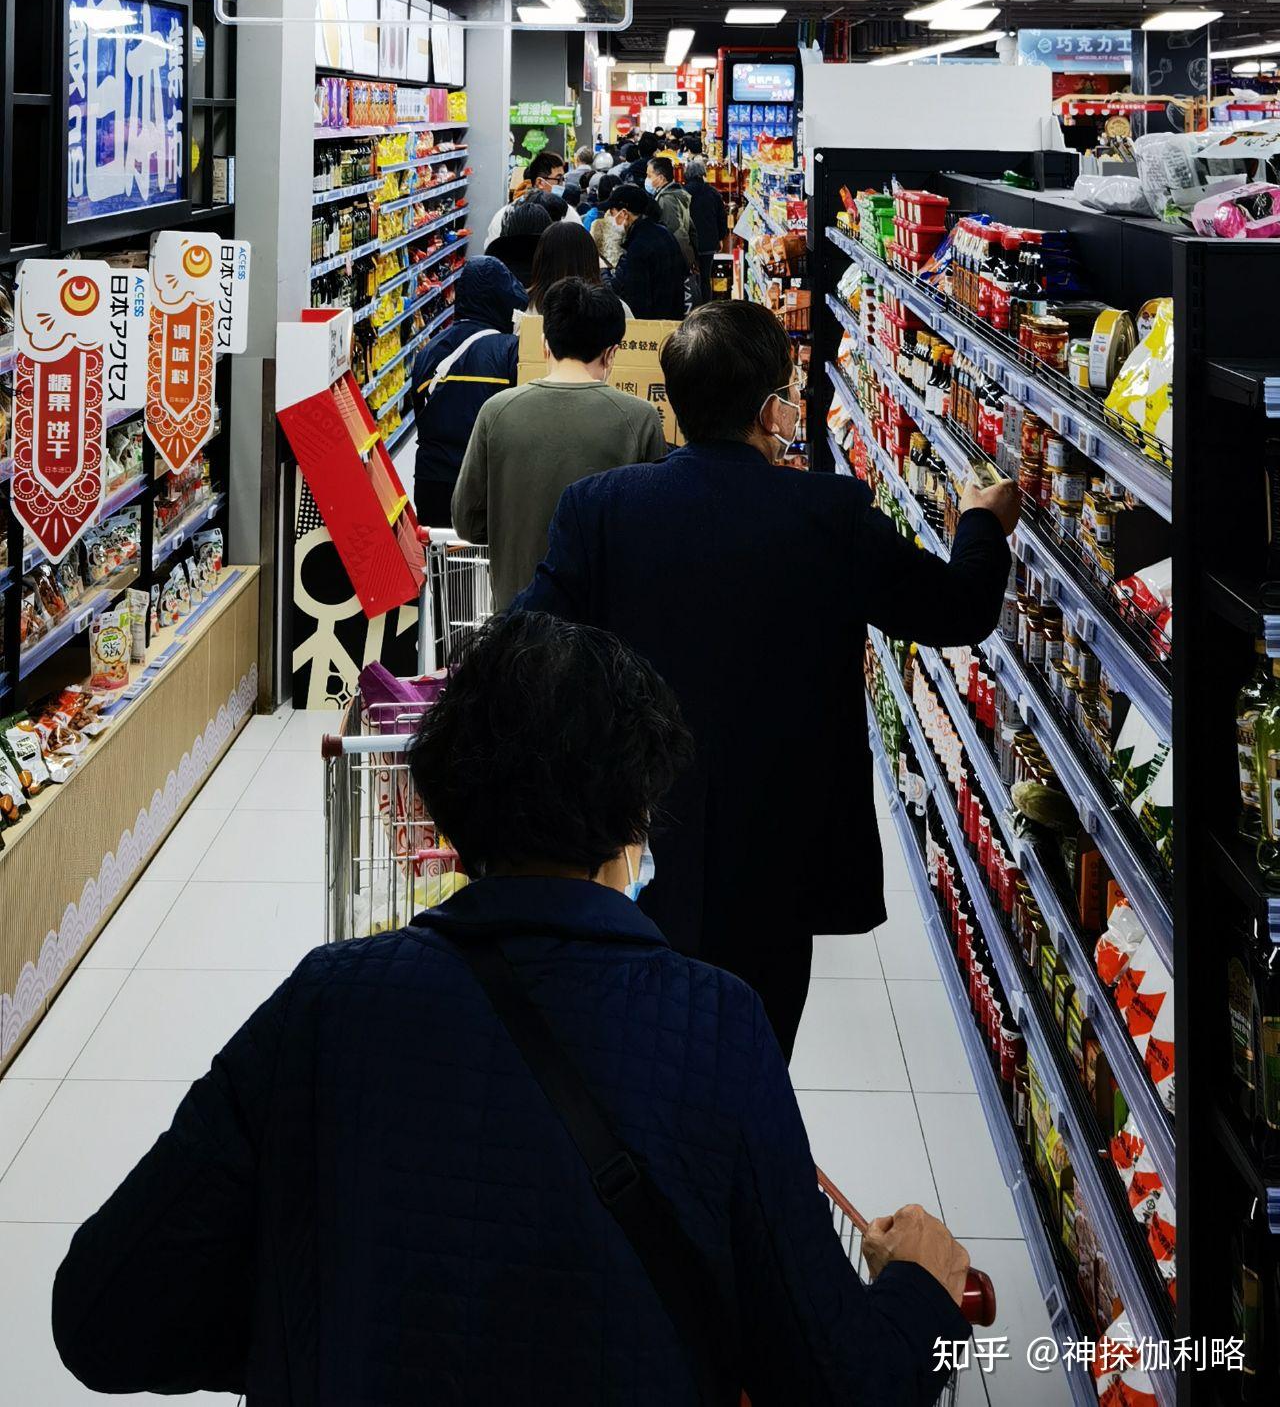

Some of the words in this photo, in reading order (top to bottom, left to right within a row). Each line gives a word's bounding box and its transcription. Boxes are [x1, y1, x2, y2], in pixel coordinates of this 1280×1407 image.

[1056, 36, 1132, 53] 巧克力工
[238, 246, 247, 281] ACCESS
[134, 276, 145, 318] ACCESS
[217, 245, 235, 347] 日本アクセス
[108, 275, 129, 402] 日本アクセス
[171, 324, 191, 384] 调味料
[618, 340, 658, 352] 轻拿轻放
[46, 421, 71, 460] 饼干
